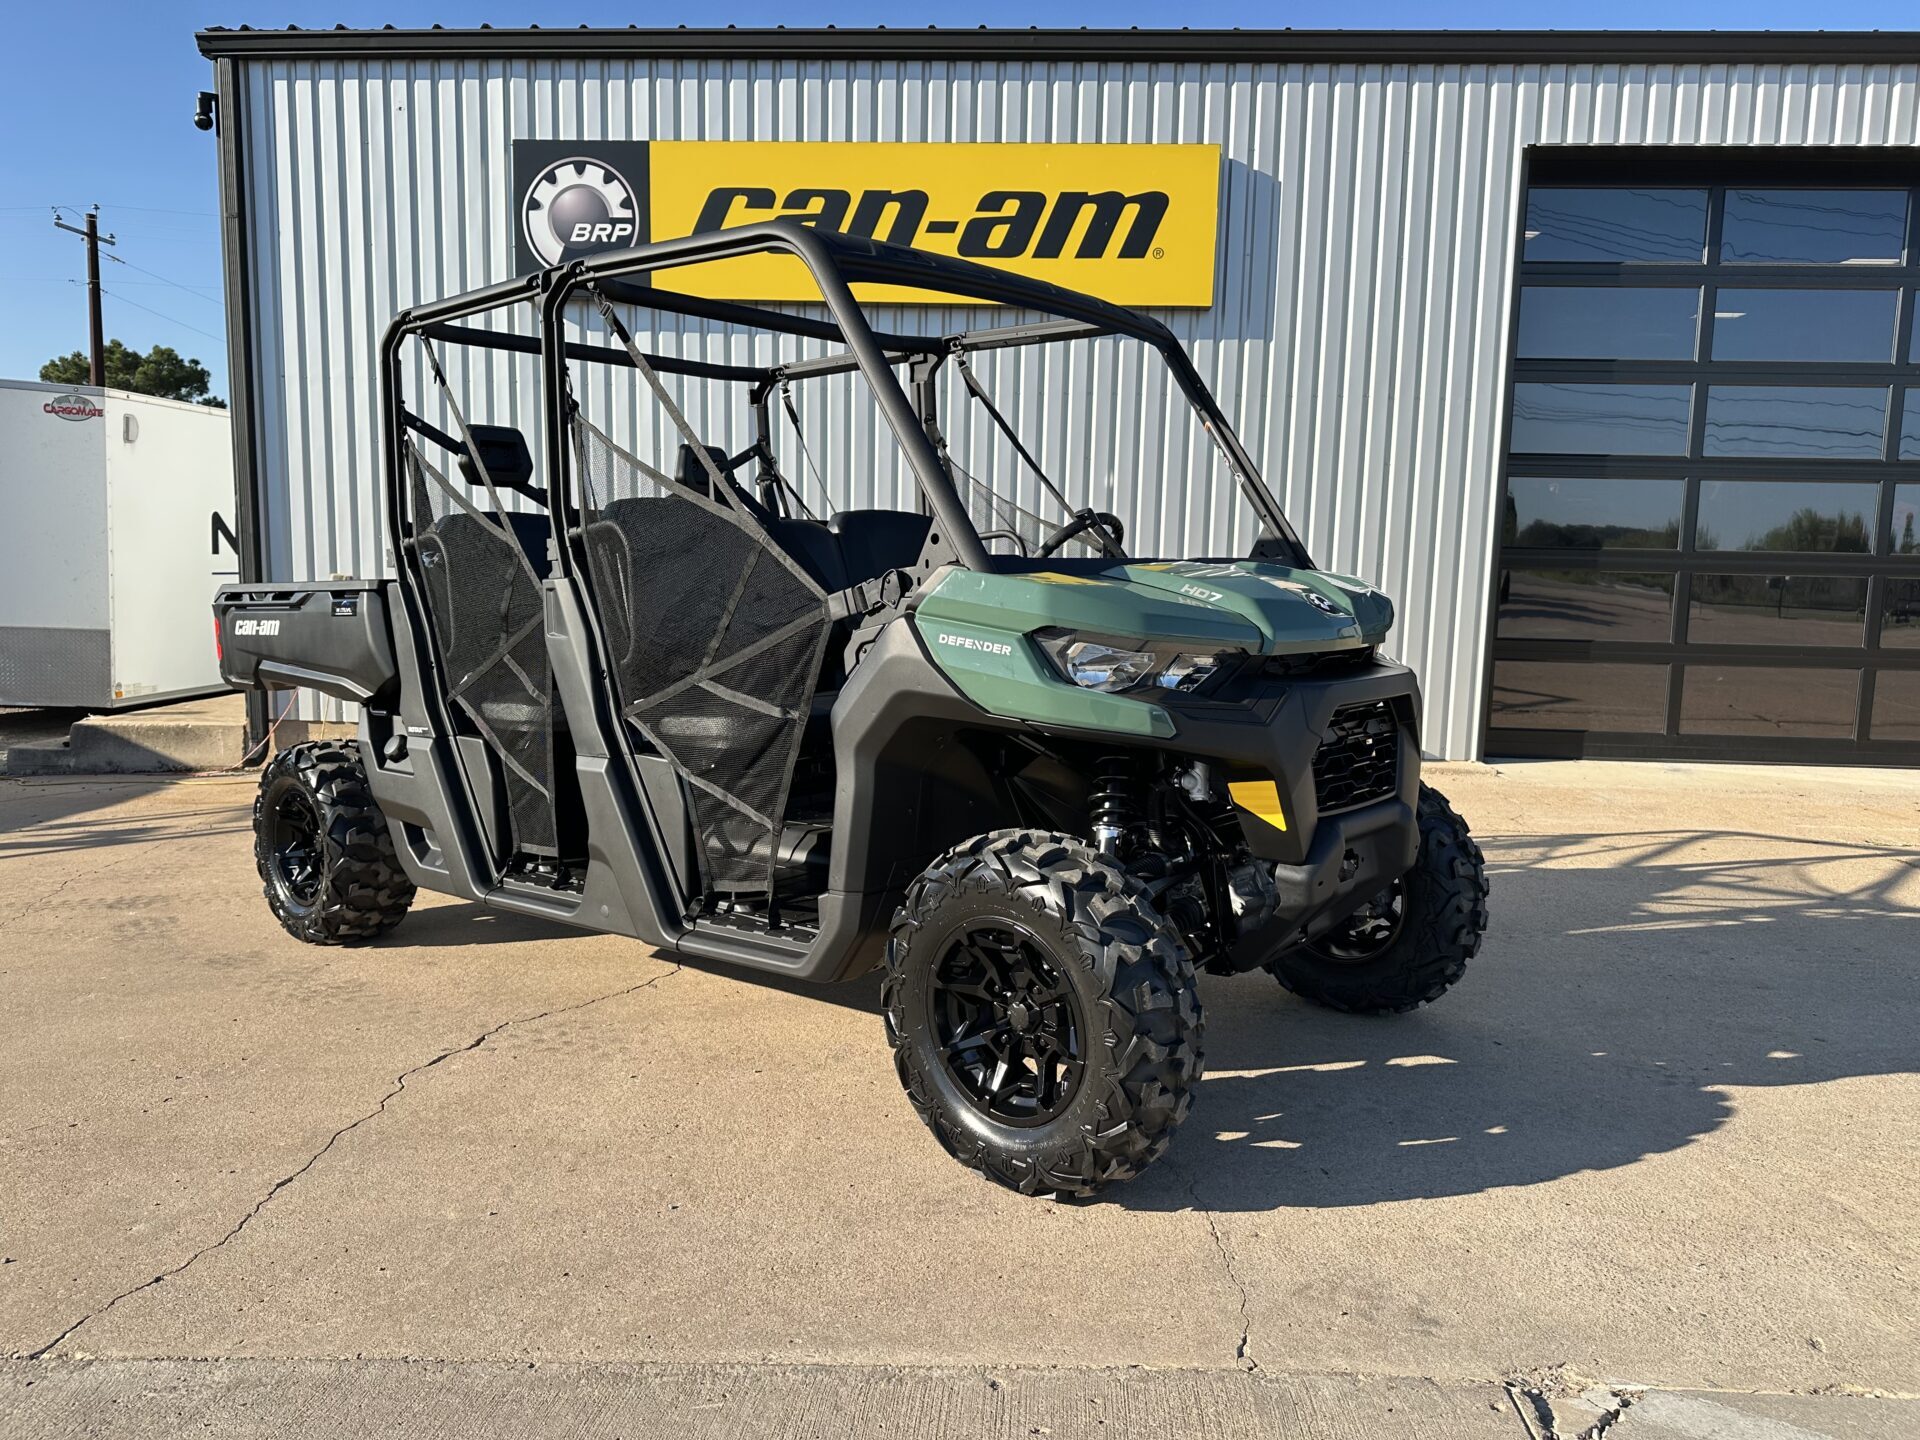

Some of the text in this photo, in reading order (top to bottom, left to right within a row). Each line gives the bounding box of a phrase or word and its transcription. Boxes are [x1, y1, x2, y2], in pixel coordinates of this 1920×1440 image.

[570, 223, 633, 242] BRP
[1180, 583, 1223, 601] HD7
[235, 620, 280, 635] can-am
[939, 633, 1012, 656] DEFENDER
